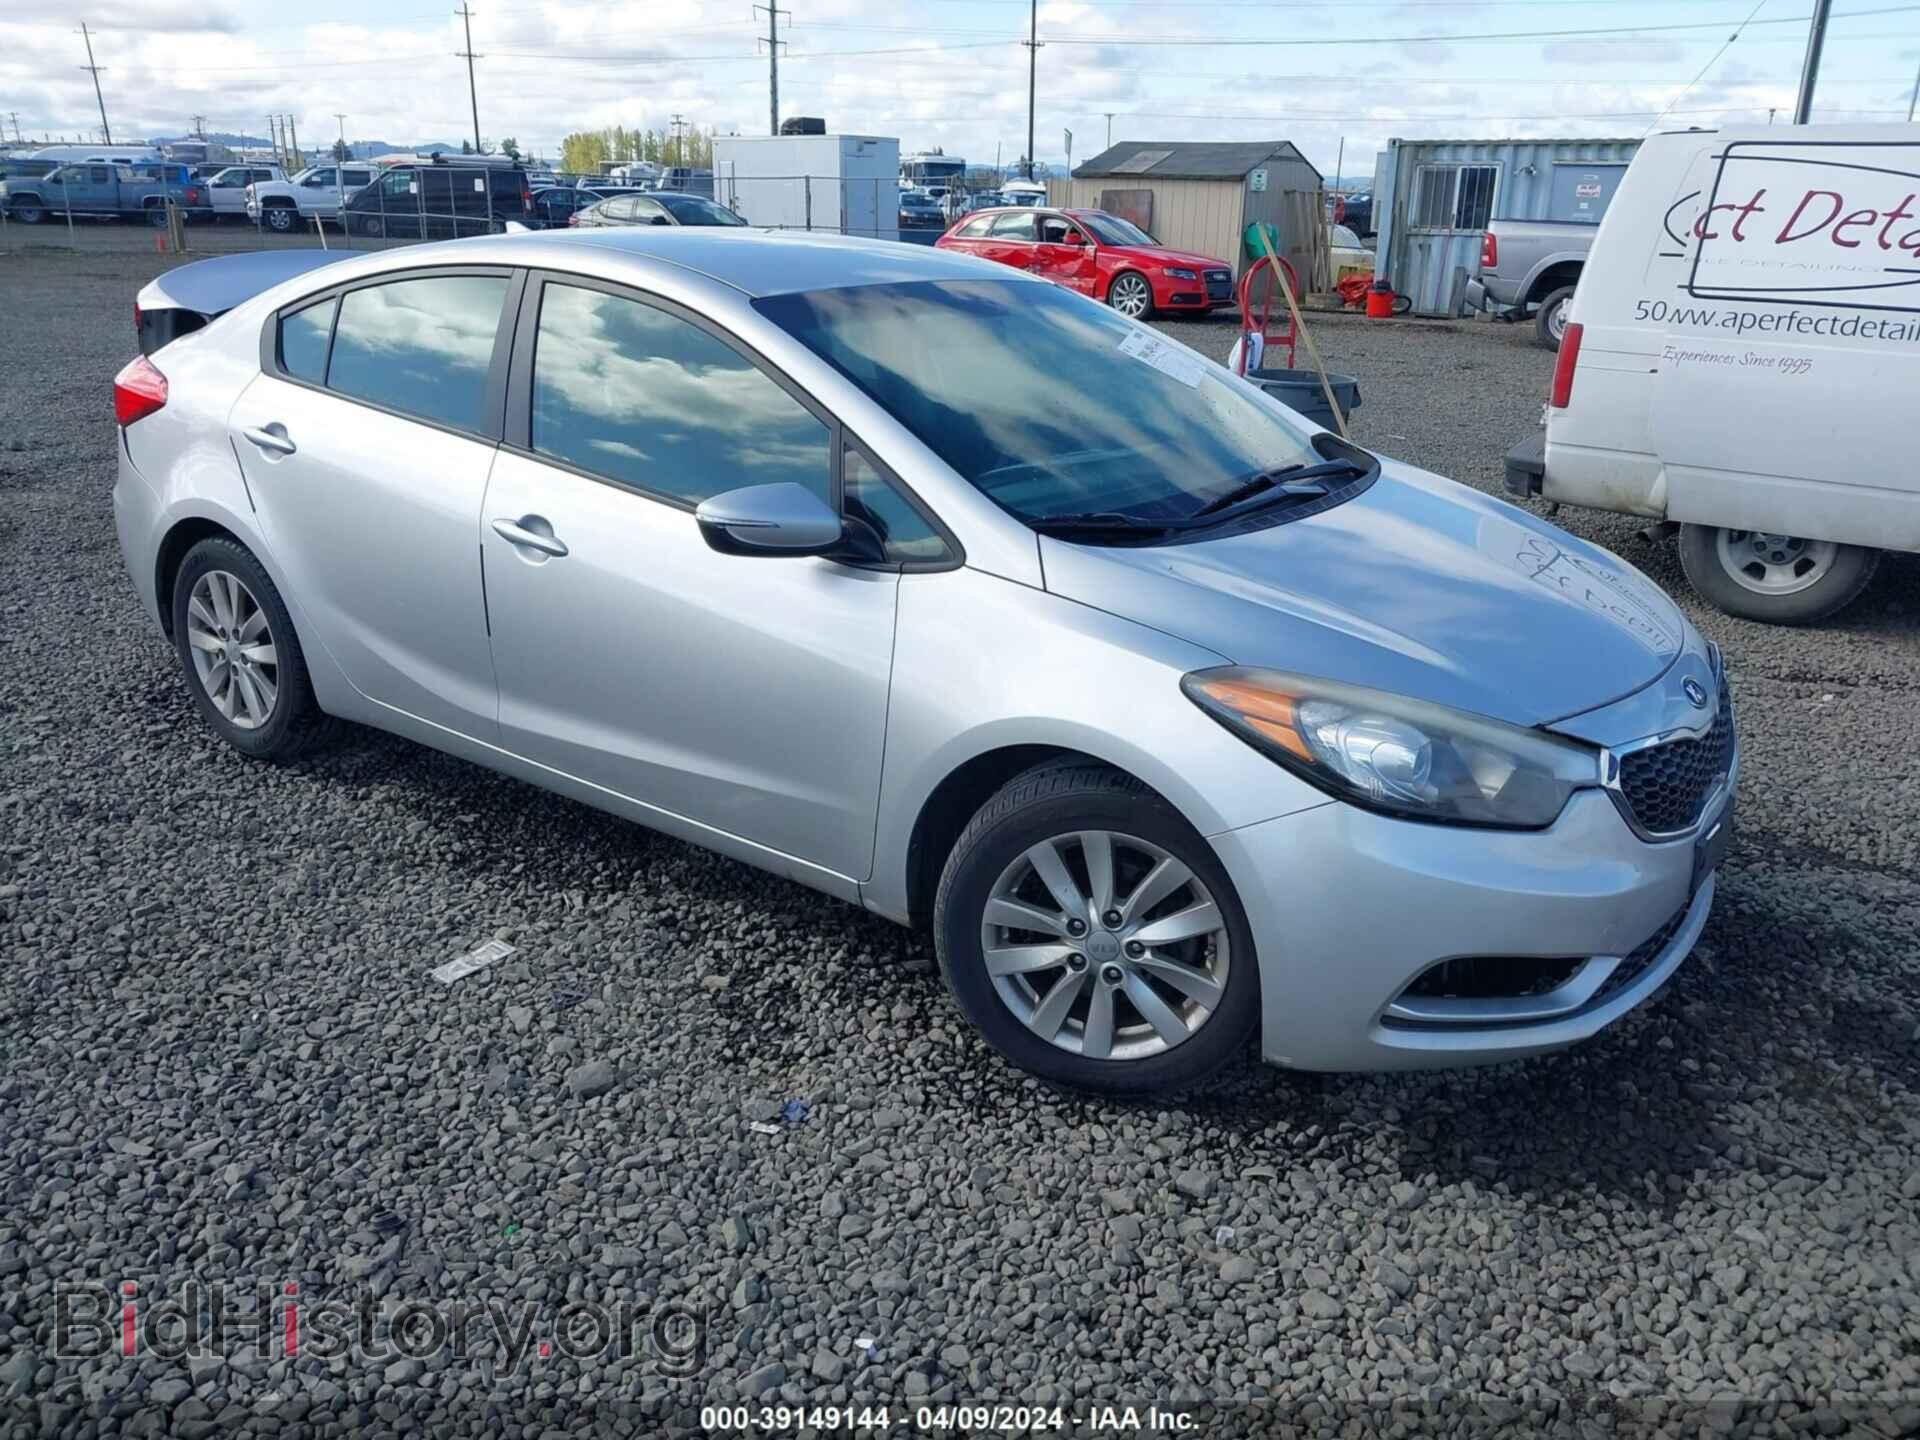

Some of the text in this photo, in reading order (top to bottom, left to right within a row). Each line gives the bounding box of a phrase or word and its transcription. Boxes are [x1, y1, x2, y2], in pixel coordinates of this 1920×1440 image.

[1662, 345, 1814, 375] Experiences Since 1995
